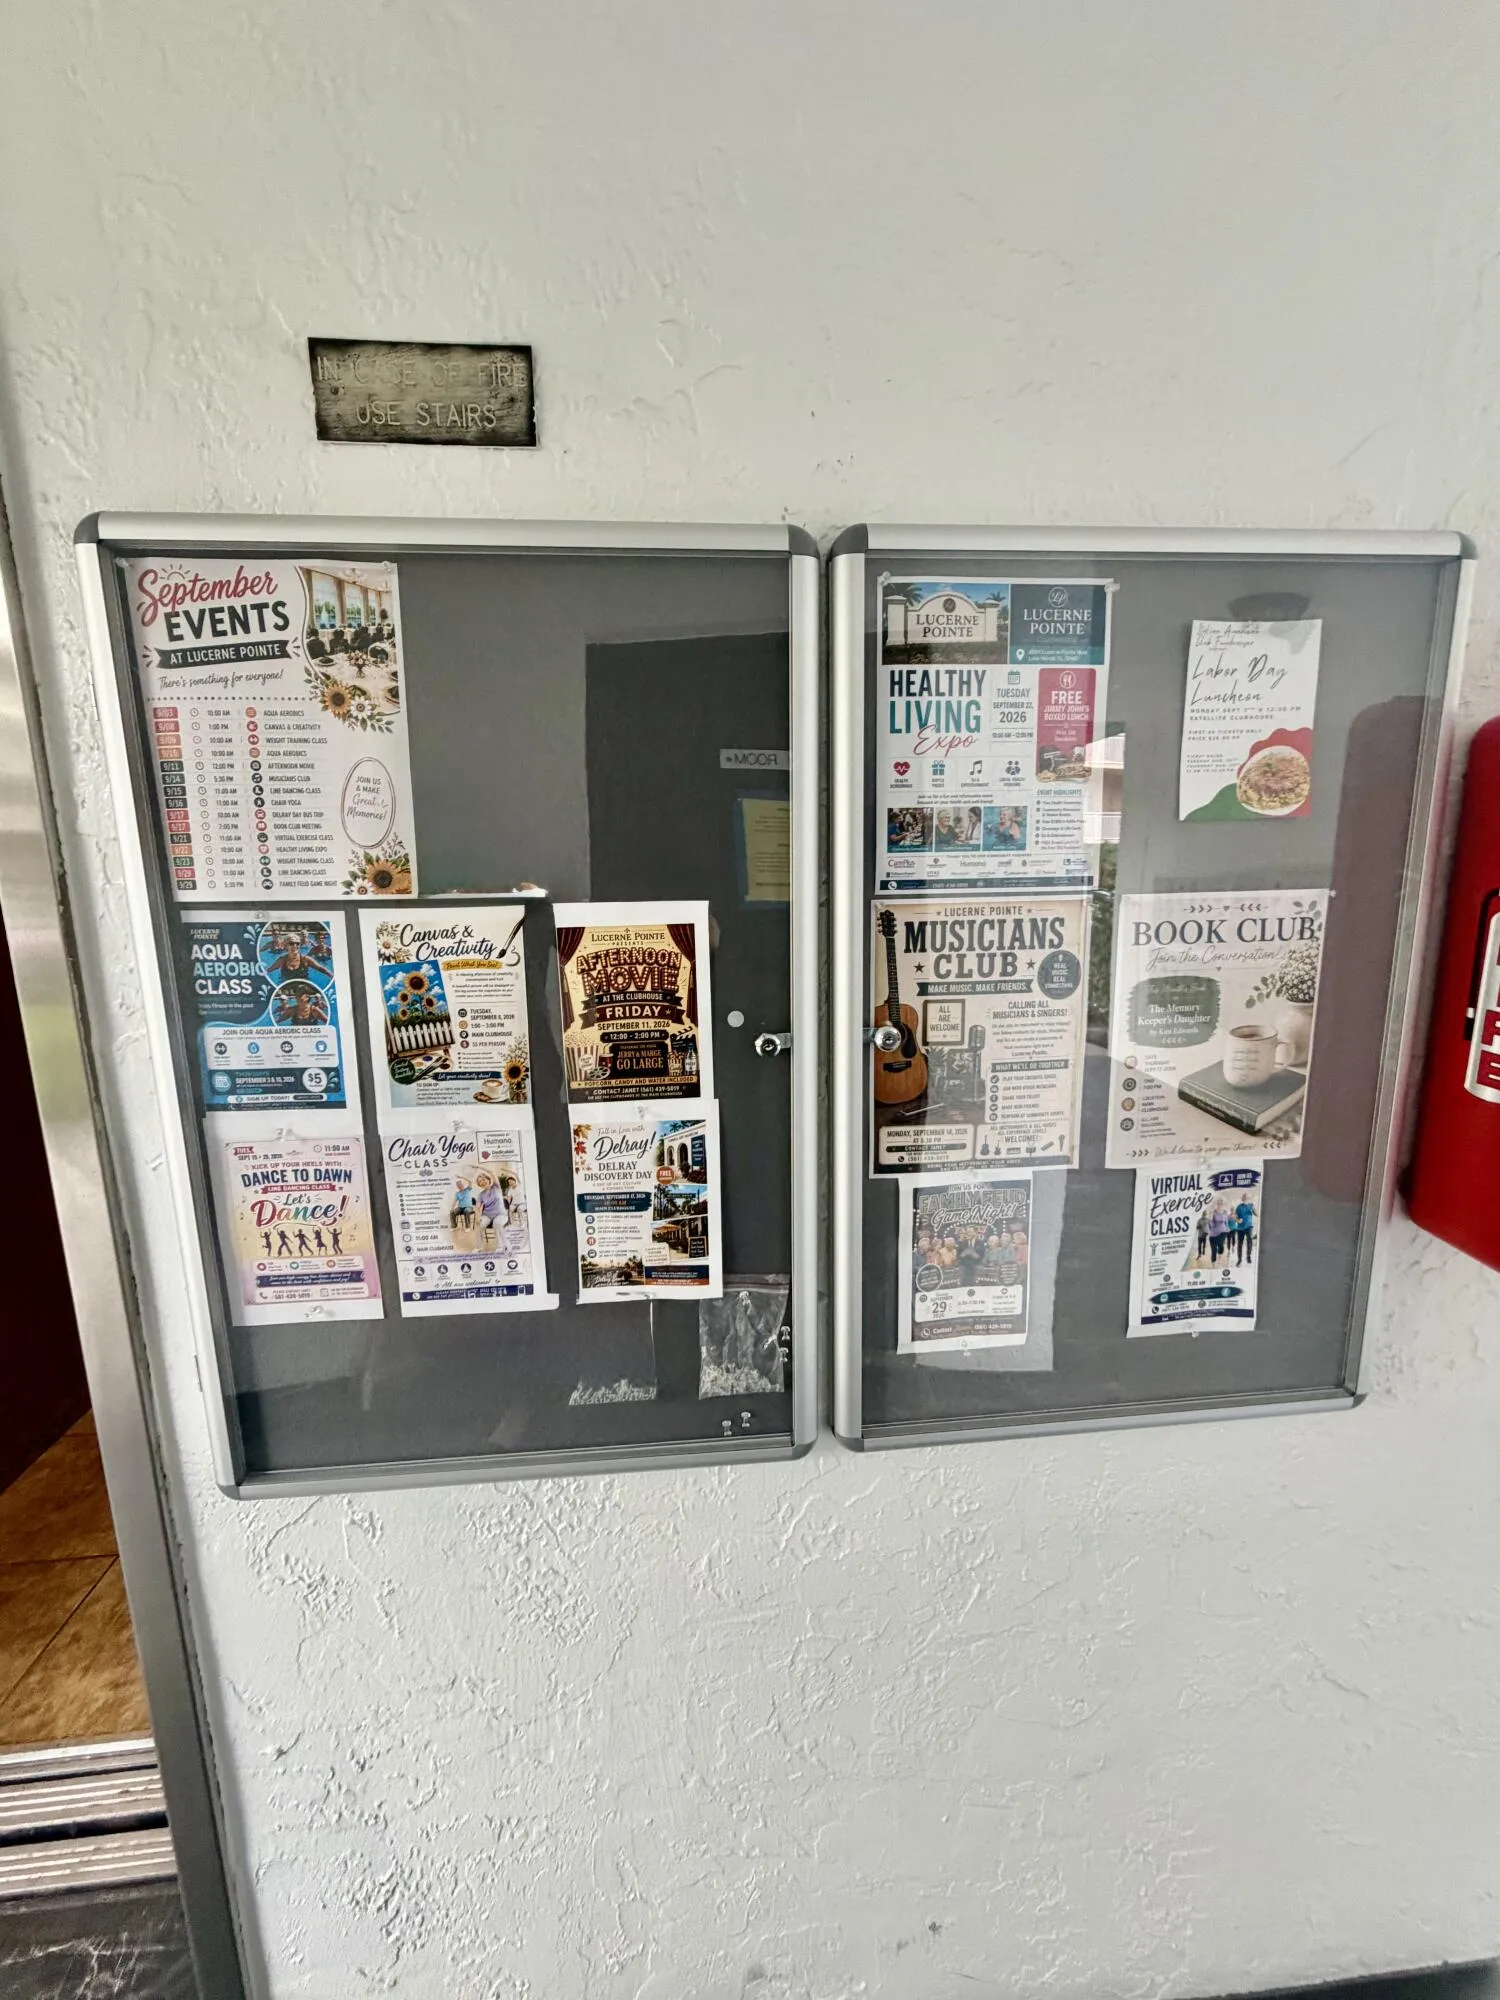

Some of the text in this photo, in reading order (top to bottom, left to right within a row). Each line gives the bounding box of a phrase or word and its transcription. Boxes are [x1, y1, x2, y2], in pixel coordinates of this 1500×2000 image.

[317, 356, 339, 381] IN
[477, 362, 527, 389] FIRE
[356, 401, 496, 428] USE STAIRS
[136, 565, 278, 627] September
[165, 600, 290, 642] EVENTS
[916, 615, 979, 625] LUCERNE
[1024, 609, 1092, 621] LUCERNE
[923, 627, 973, 637] POINTE
[1030, 623, 1084, 635] POINTE
[170, 644, 281, 665] AT LUCERNE POINTE
[159, 669, 285, 689] There's something for everyone!
[1192, 652, 1288, 690] Labor Day
[890, 670, 987, 697] HEALTHY
[997, 688, 1030, 697] TUESDAY
[1051, 691, 1082, 704] FREE
[1191, 679, 1261, 706] Luncheon
[890, 700, 981, 734] LIVING
[1000, 712, 1026, 723] 2026
[913, 725, 977, 758] Expo
[363, 786, 380, 794] MAKE
[944, 906, 1023, 917] LUCERNE POINTE
[400, 923, 474, 947] Canvas &
[904, 917, 1065, 953] MUSICIANS
[1132, 916, 1315, 947] BOOK CLUB
[191, 944, 243, 960] AQUA
[416, 938, 498, 961] Creativity
[1178, 947, 1198, 963] the
[577, 947, 682, 974] AFTERNOON
[934, 952, 1018, 979] CLUB
[193, 962, 266, 976] AEROBIC
[195, 979, 252, 994] CLASS
[582, 966, 679, 996] MOVIE
[928, 984, 948, 993] MAKE
[976, 983, 995, 992] MAKE
[606, 1006, 661, 1018] FRIDAY
[1008, 1000, 1049, 1010] CALLING ALL
[1150, 1003, 1200, 1014] The Memory
[938, 1014, 951, 1022] ARE
[992, 1009, 1067, 1019] MUSICIANS & SINGERS!
[1137, 1014, 1211, 1025] Keeper's Daughter
[598, 1022, 639, 1030] SEPTEMBER
[930, 1024, 960, 1032] WELCOME
[617, 1057, 663, 1070] GO LARGE
[308, 1073, 322, 1082] $5
[388, 1135, 475, 1162] Chair Yoga
[593, 1132, 656, 1160] Delray!
[404, 1157, 448, 1169] CLASS
[599, 1161, 637, 1171] DELRAY
[241, 1168, 352, 1188] DANCE TO DAWN
[584, 1171, 652, 1181] DISCOVERY DAY
[1151, 1174, 1202, 1195] VIRTUAL
[283, 1194, 311, 1206] Let's
[1150, 1191, 1213, 1220] Exercise
[251, 1195, 347, 1227] Dance!
[932, 1202, 1018, 1231] Game Night!
[1151, 1216, 1190, 1236] CLASS
[932, 1302, 947, 1313] 29
